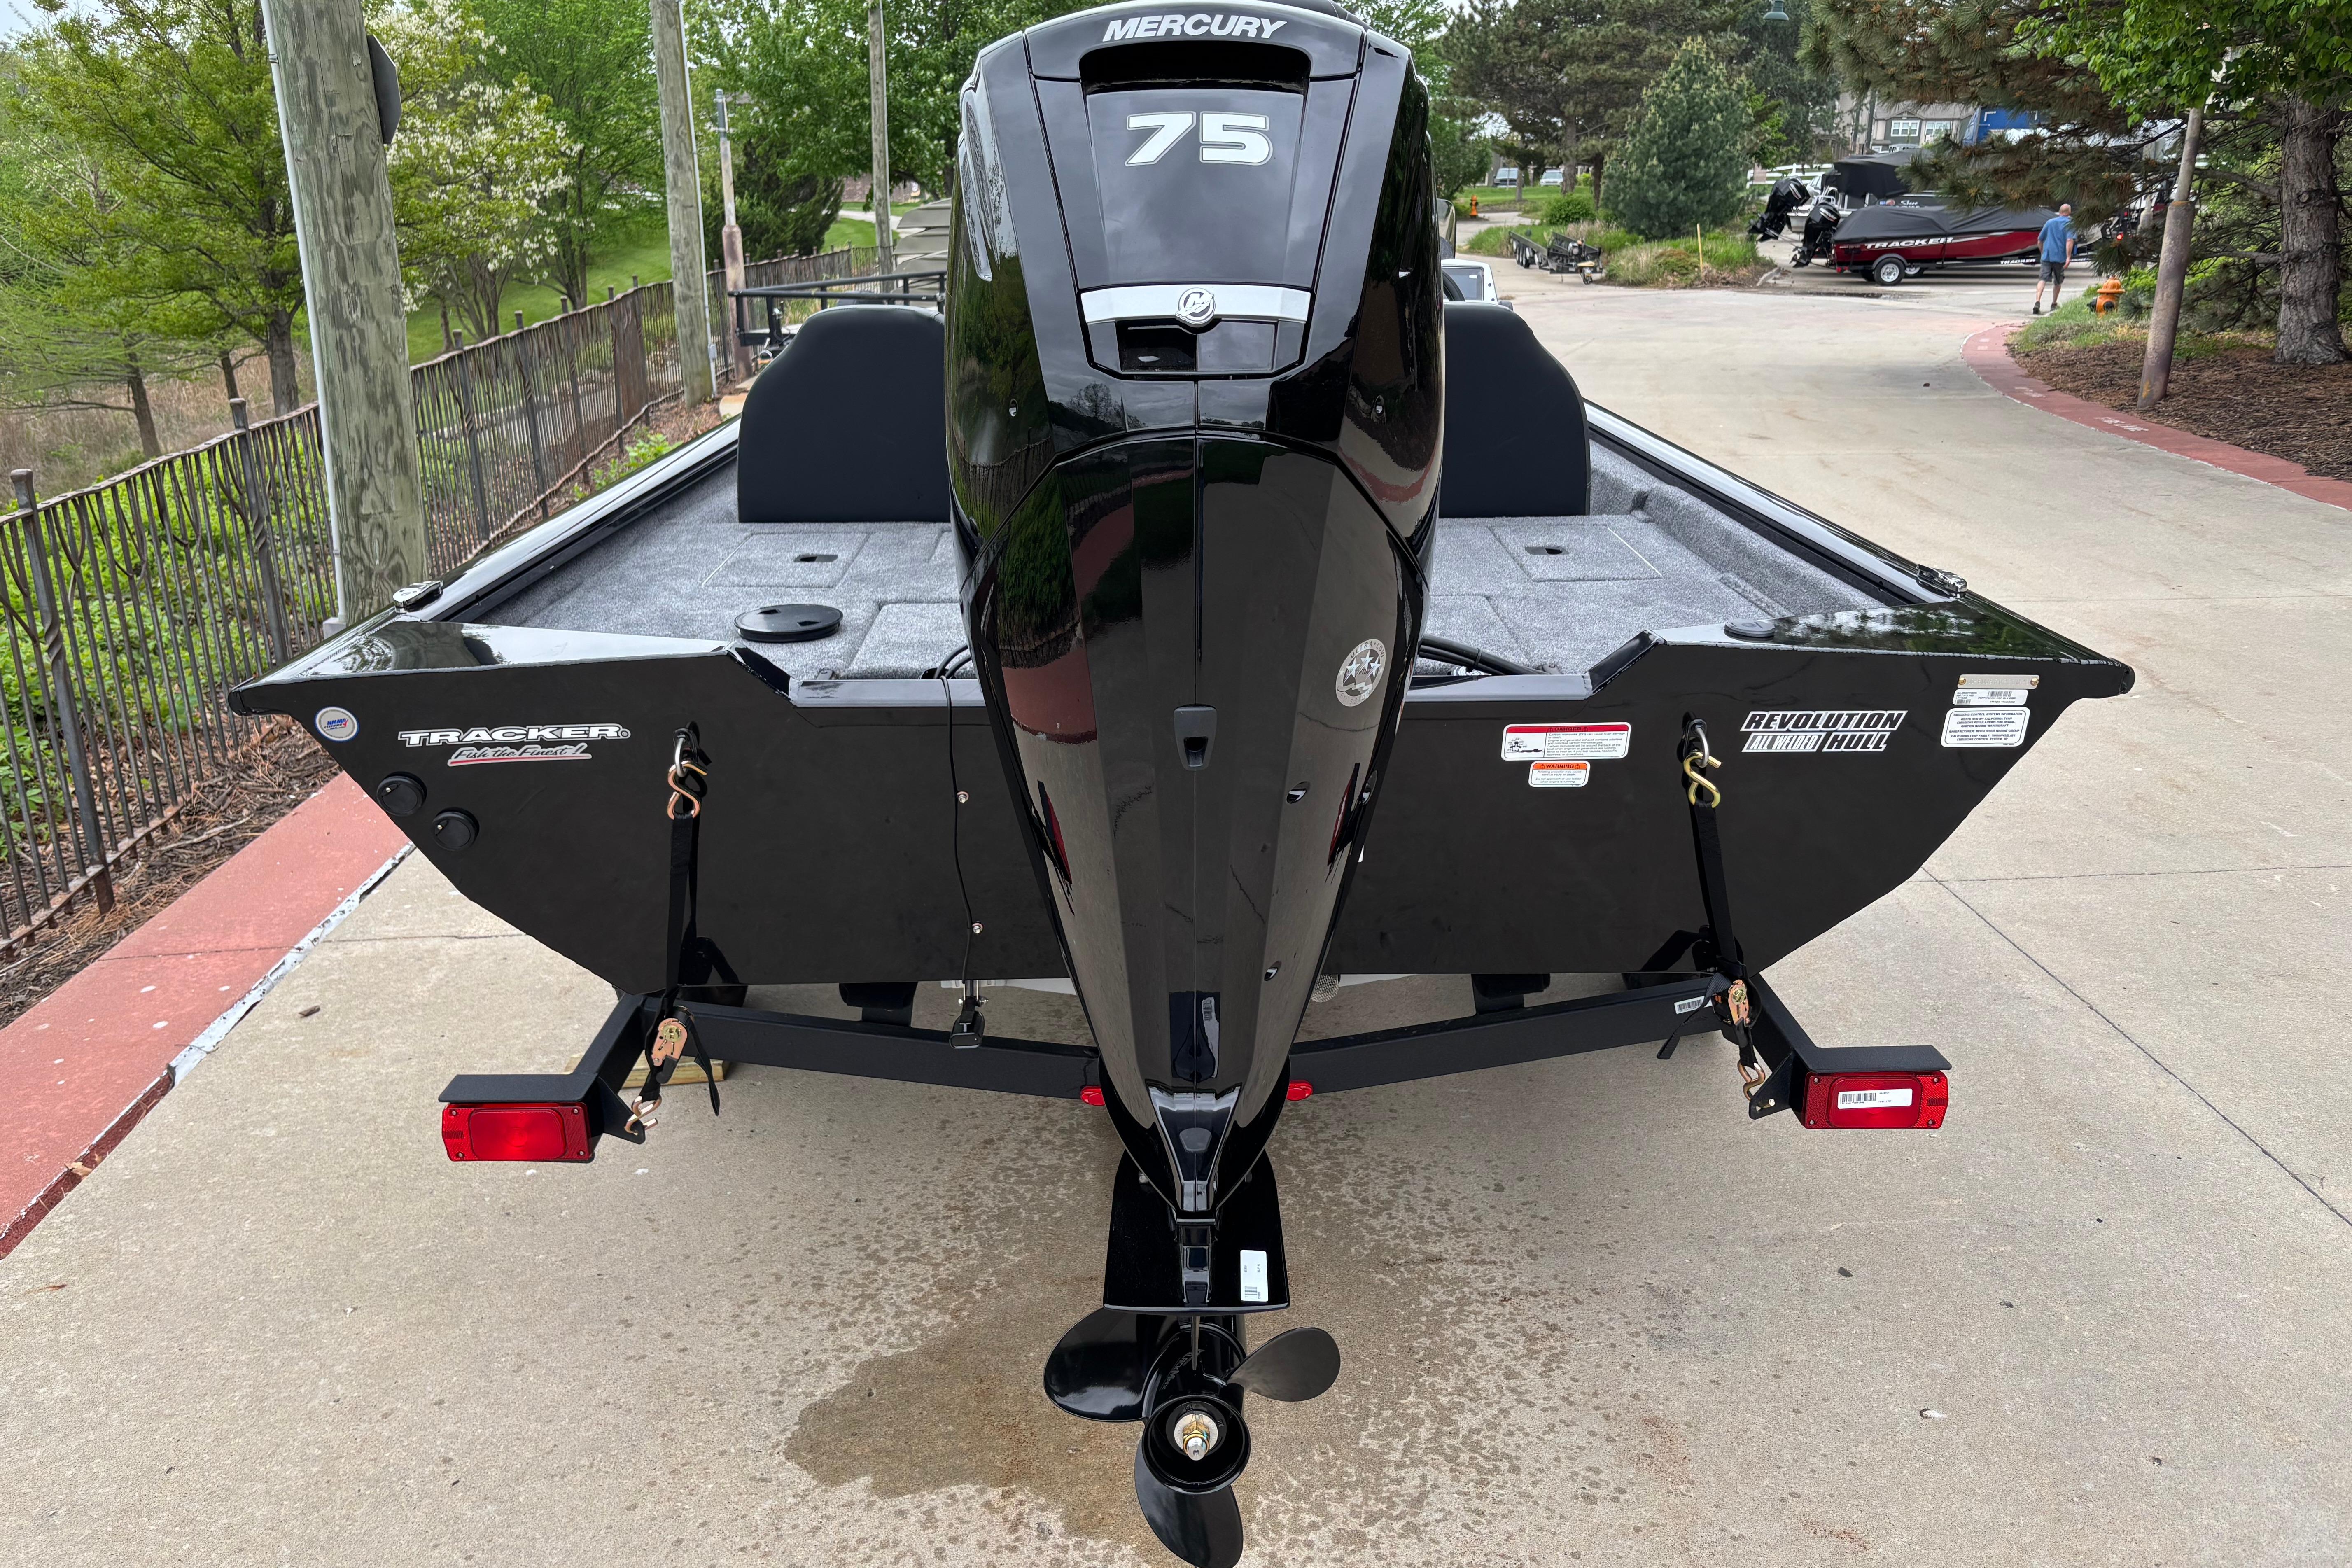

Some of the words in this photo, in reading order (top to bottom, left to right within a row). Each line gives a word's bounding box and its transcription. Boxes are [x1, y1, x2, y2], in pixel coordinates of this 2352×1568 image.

[1102, 14, 1288, 42] MERCURY
[1125, 111, 1273, 166] 75
[1864, 237, 1953, 249] TRACKER
[1351, 641, 1372, 658] ULTRA
[1744, 712, 1904, 730] REVOLUTION
[401, 726, 620, 744] TRACKER
[1750, 735, 1769, 750] ALL
[1772, 735, 1820, 750] WELDED
[1826, 734, 1887, 750] HULL
[454, 749, 489, 759] Fish
[492, 749, 516, 758] the
